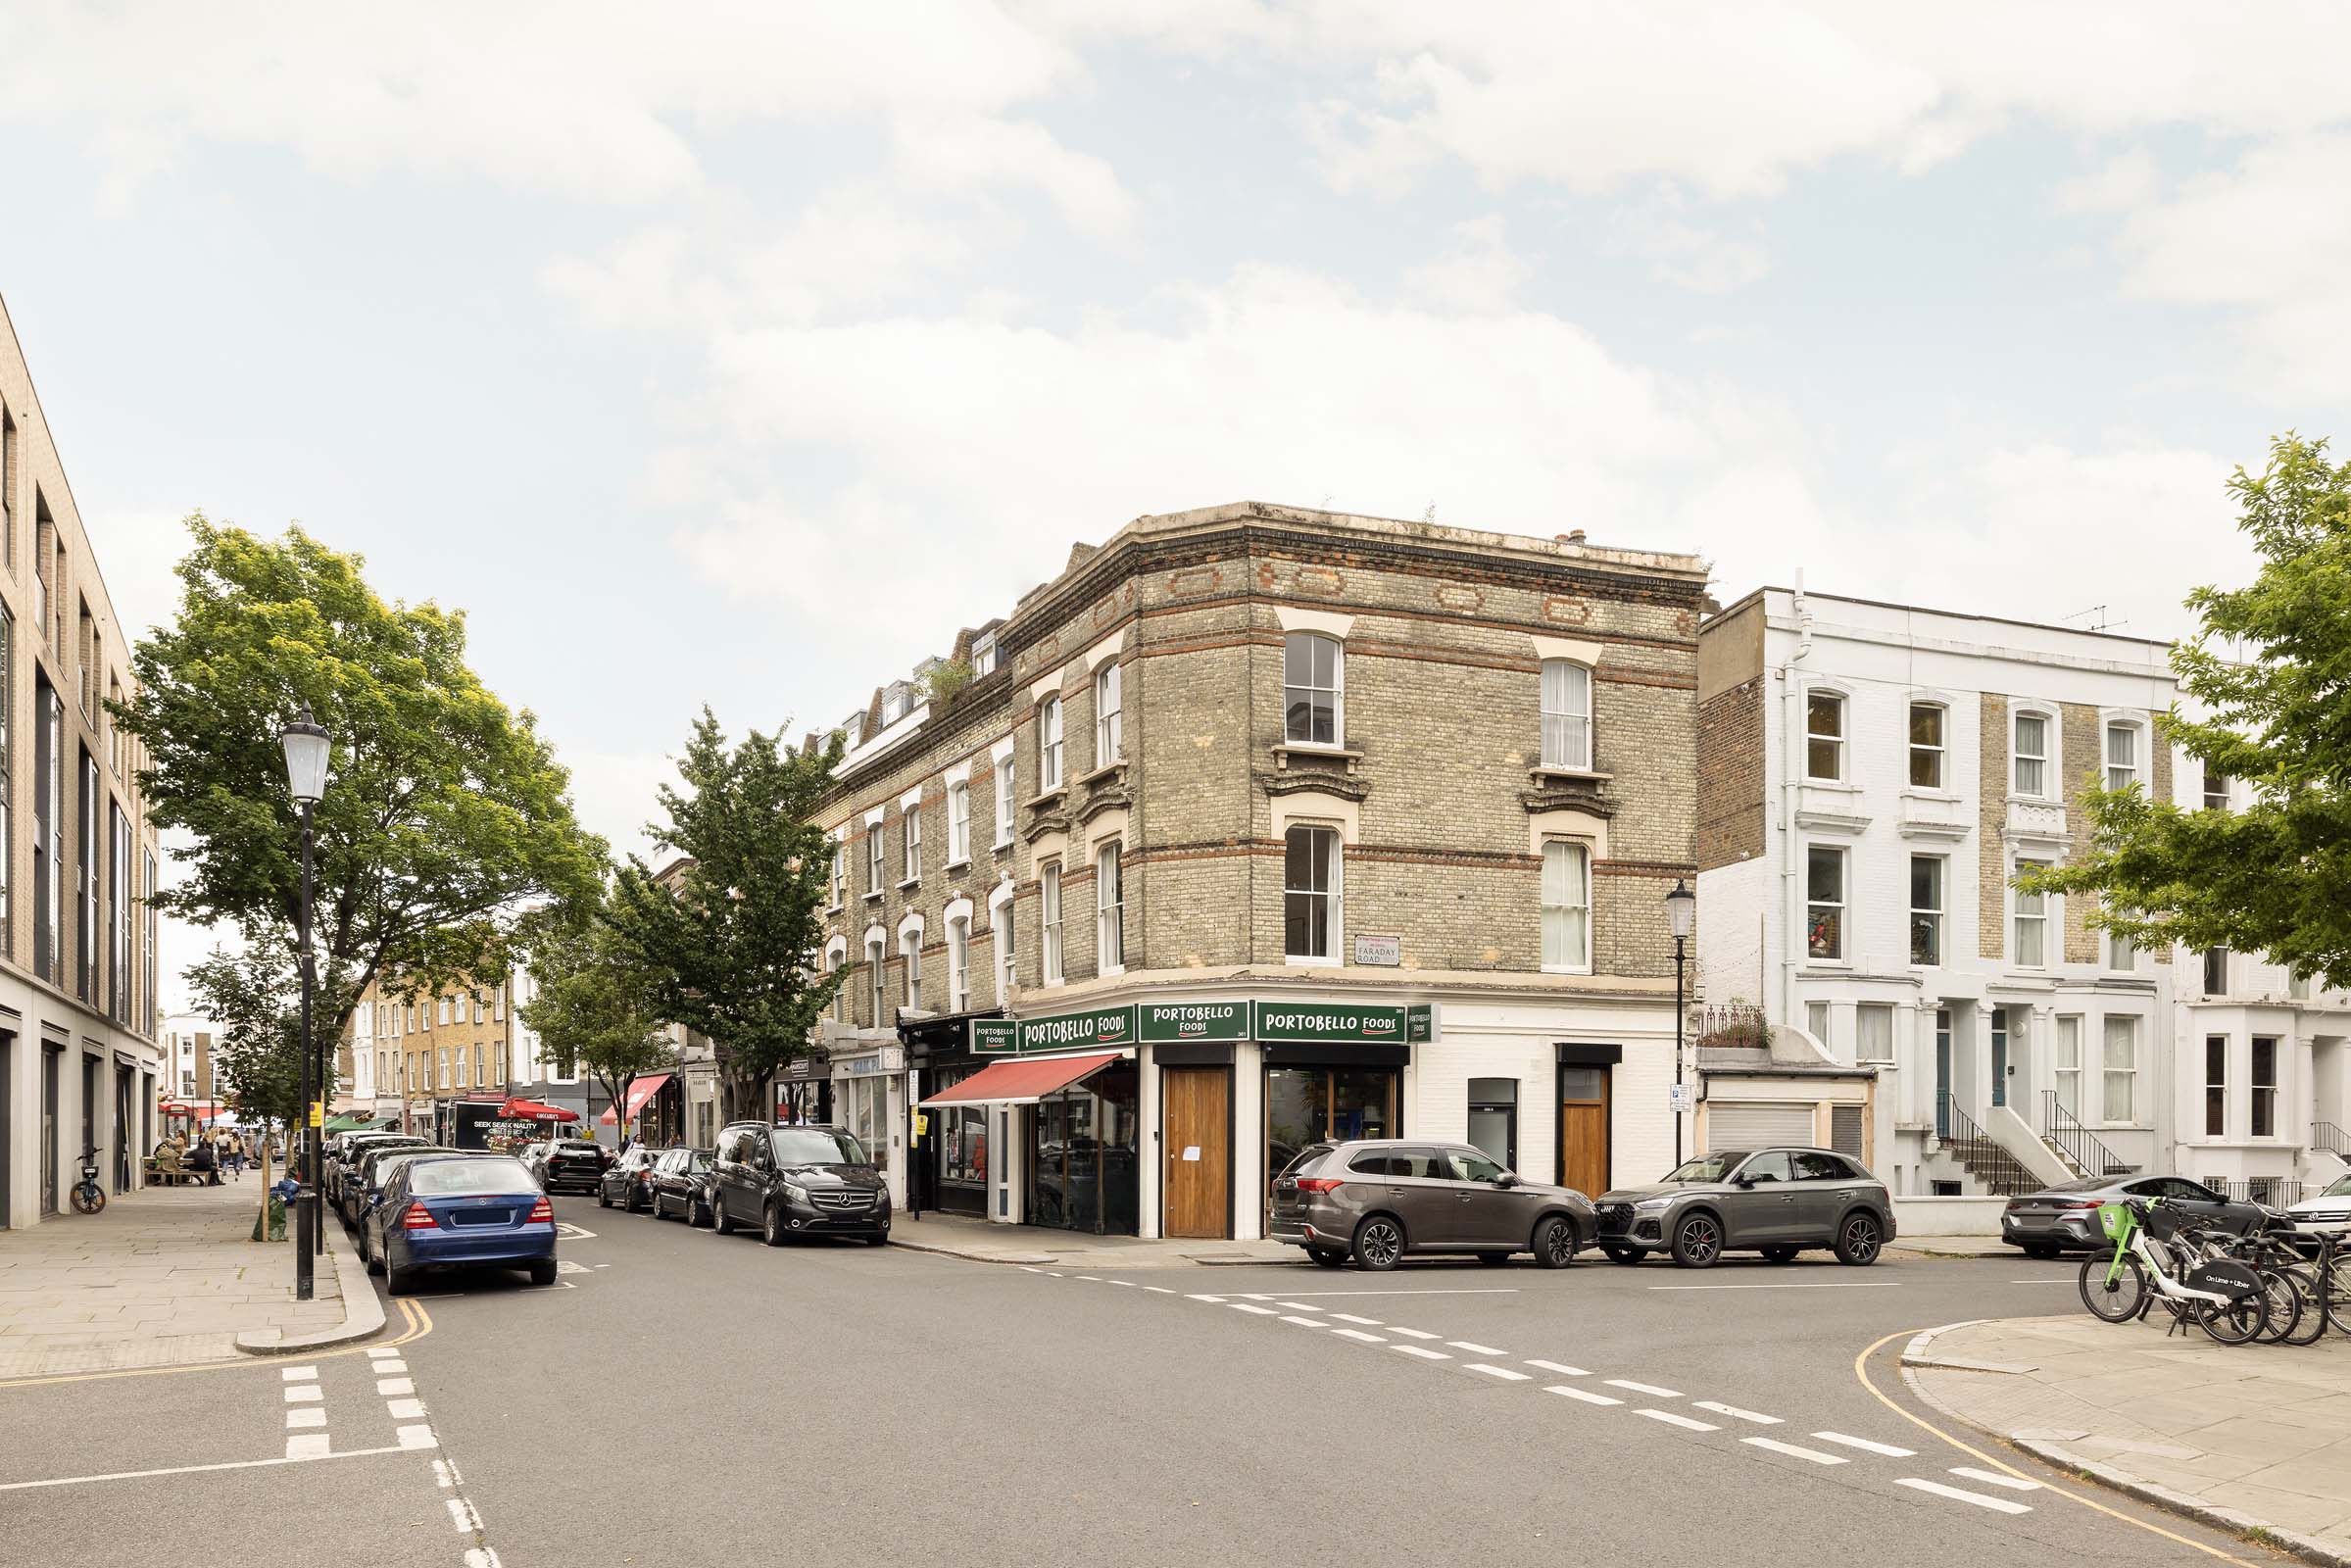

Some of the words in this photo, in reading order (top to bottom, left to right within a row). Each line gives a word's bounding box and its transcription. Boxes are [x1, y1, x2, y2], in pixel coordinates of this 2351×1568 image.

[1358, 948, 1396, 956] FARADAY
[1357, 955, 1381, 963] ROAD
[1153, 1006, 1234, 1023] PORTOBELLO
[1408, 1013, 1431, 1024] PORTOBELLO
[1179, 1022, 1207, 1032] FOODS
[1265, 1013, 1357, 1032] PORTOBELLO
[1362, 1016, 1396, 1030] FOODS
[976, 1027, 1014, 1036] PORTOBELLO
[1024, 1019, 1094, 1048] PORTOBELLO
[1098, 1014, 1126, 1034] FOODS
[1413, 1024, 1425, 1033] FOODS
[986, 1036, 1005, 1045] FOODS
[2215, 1276, 2229, 1285] Lime
[2233, 1280, 2250, 1289] Uber
